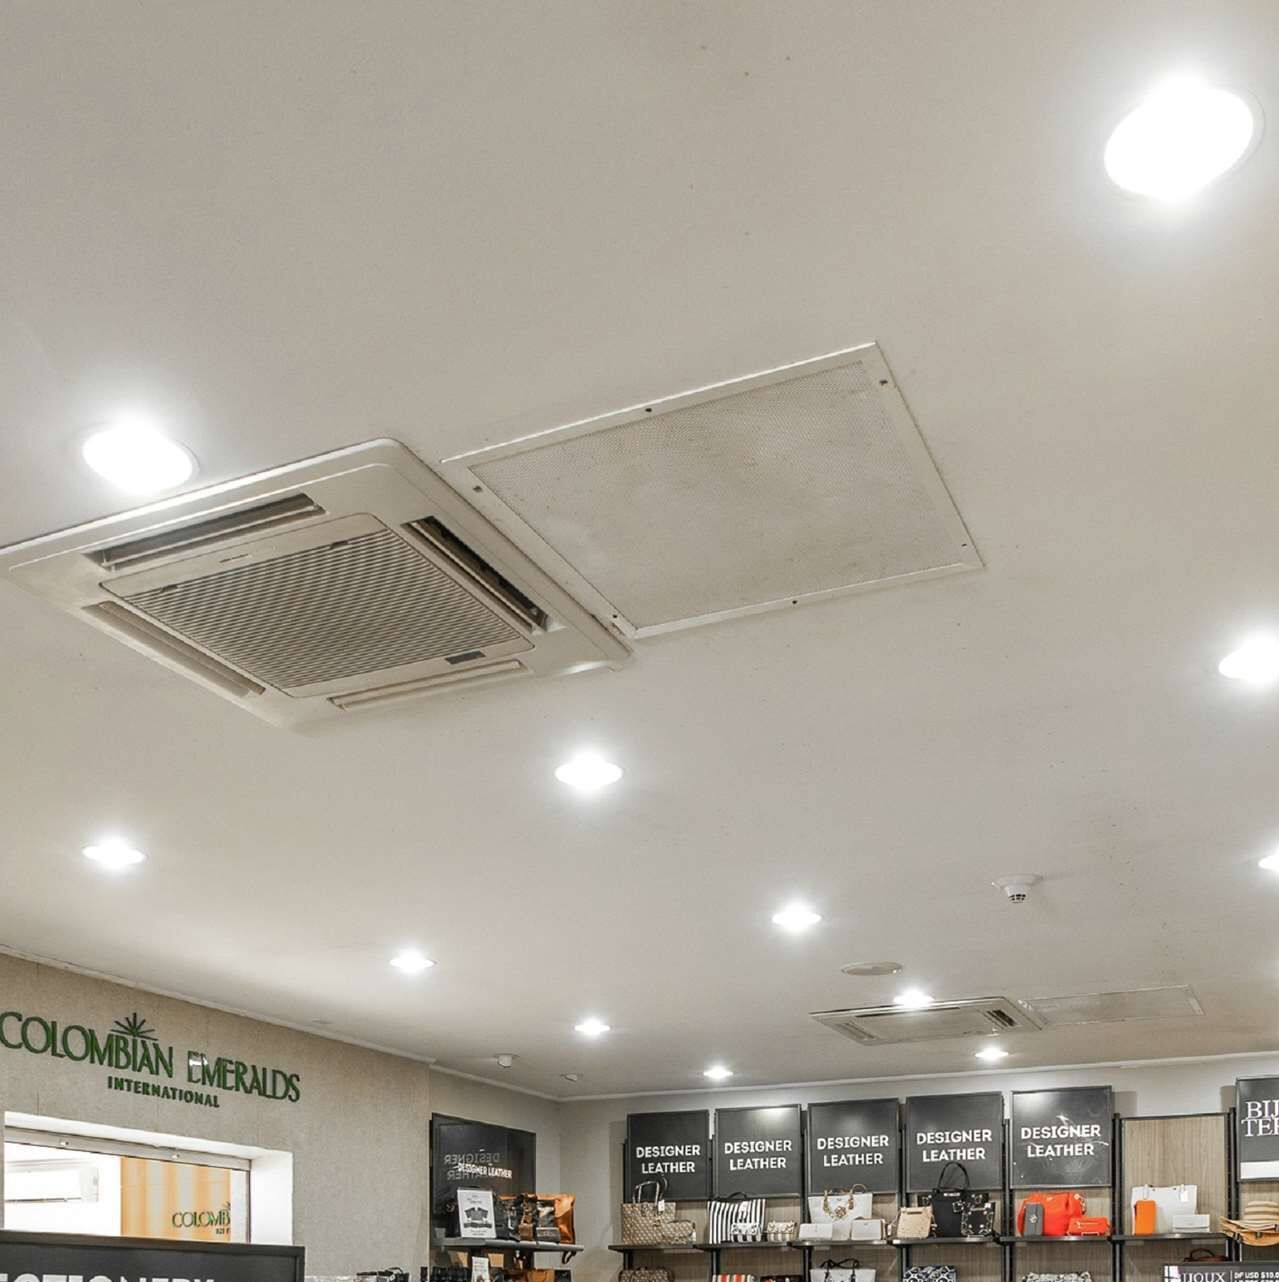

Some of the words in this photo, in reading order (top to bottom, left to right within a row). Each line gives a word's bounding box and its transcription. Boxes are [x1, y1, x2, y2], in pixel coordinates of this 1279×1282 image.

[187, 1050, 300, 1103] EMERALDS
[108, 1076, 220, 1108] INTERNATIONAL
[917, 1129, 992, 1145] DESIGNER
[1021, 1125, 1101, 1139] DESIGNER
[725, 1140, 792, 1154] DESIGNER
[817, 1135, 889, 1150] DESIGNER
[636, 1145, 701, 1158] DESIGNER
[922, 1147, 985, 1163] LEATHER
[1027, 1143, 1094, 1158] LEATHER
[730, 1157, 786, 1171] LEATHER
[823, 1153, 883, 1167] LEATHER
[488, 1168, 512, 1179] LEATHER
[642, 1162, 695, 1174] LEATHER
